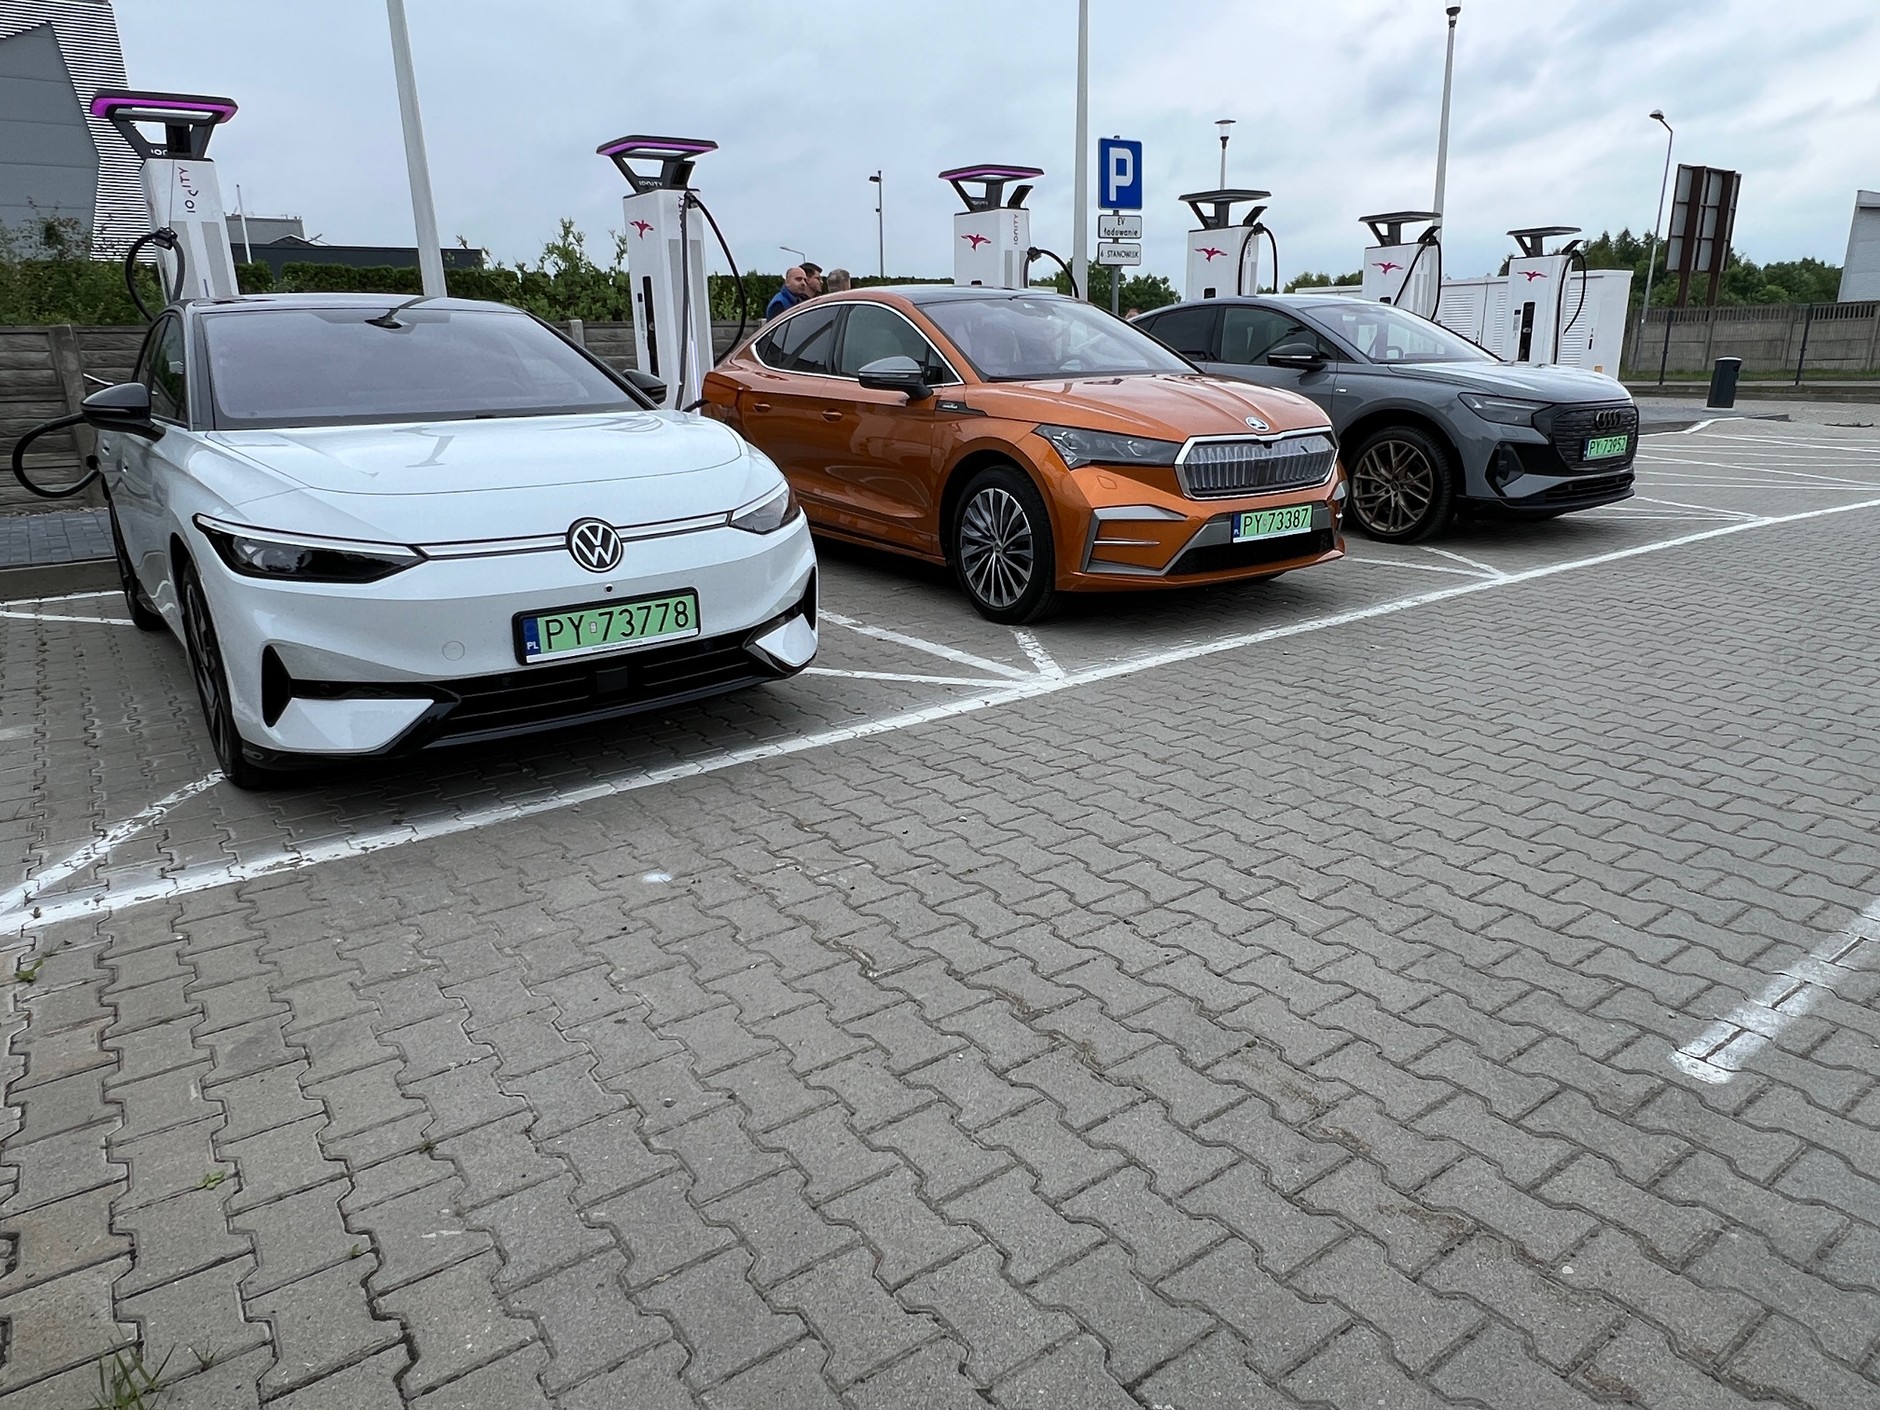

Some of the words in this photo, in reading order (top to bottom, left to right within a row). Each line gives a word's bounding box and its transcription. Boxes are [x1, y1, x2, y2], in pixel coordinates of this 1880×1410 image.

[1109, 147, 1134, 202] P
[1117, 217, 1126, 226] EV
[1589, 440, 1601, 455] PY
[1243, 513, 1264, 536] PY
[1268, 508, 1309, 533] 73387
[545, 614, 585, 649] PY
[598, 600, 690, 642] 73778
[527, 641, 539, 650] PL
